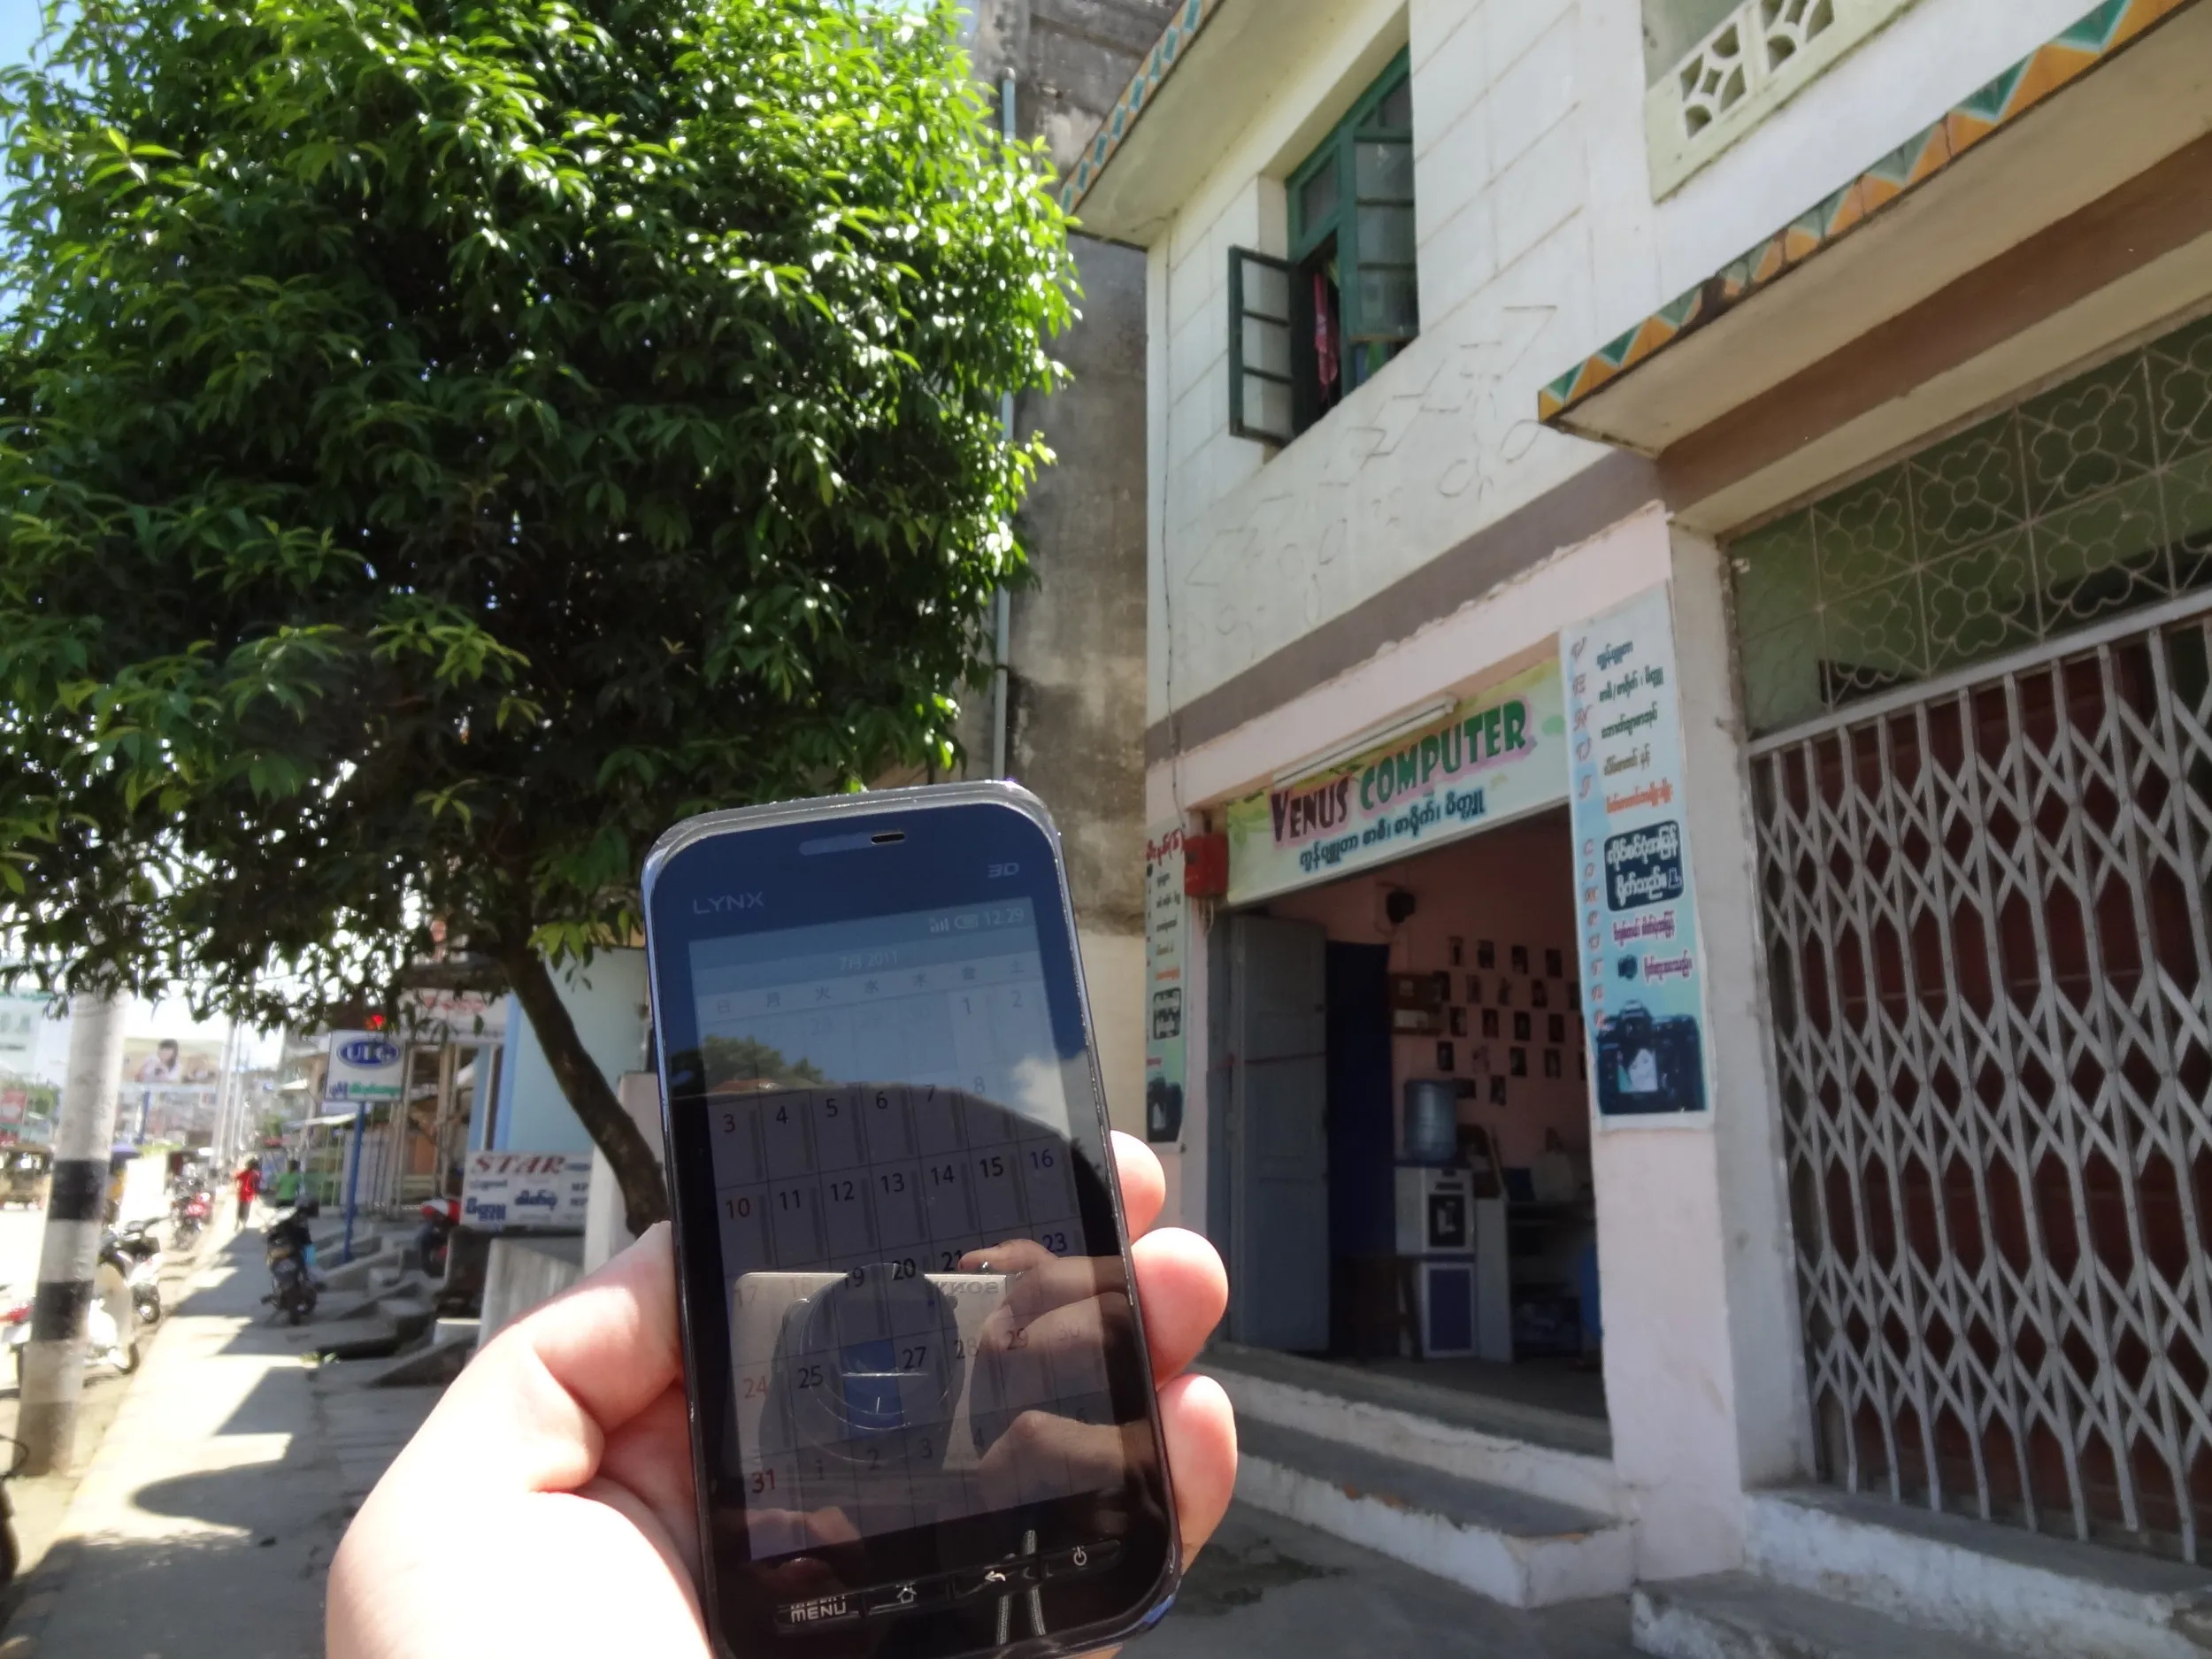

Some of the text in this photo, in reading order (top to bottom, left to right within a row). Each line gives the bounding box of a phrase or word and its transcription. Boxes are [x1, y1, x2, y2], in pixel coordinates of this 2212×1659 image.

[1270, 700, 1527, 842] VENUS COMPUTER
[987, 862, 1020, 878] 3D
[692, 891, 764, 915] LYNX
[717, 999, 732, 1014] 日
[815, 986, 832, 1002] 火
[960, 996, 972, 1016] 1
[1010, 989, 1023, 1008] 2
[723, 1114, 736, 1133] 3
[775, 1106, 789, 1125] 4
[826, 1098, 839, 1118] 5
[875, 1090, 889, 1110] 6
[973, 1076, 986, 1094] 8
[471, 1154, 565, 1175] STAR
[726, 1148, 1054, 1219] 10 11 12 13 14 15 16
[843, 1267, 865, 1288] 19
[893, 1257, 917, 1281] 20
[1041, 1232, 1067, 1253] 23
[744, 1376, 768, 1399] 24
[797, 1363, 825, 1388] 25
[902, 1345, 927, 1369] 27
[955, 1337, 979, 1360] 28
[1007, 1326, 1028, 1350] 29
[751, 1468, 776, 1494] 31
[868, 1446, 880, 1470] 2
[919, 1437, 933, 1460] 3
[790, 1599, 847, 1624] MENU
